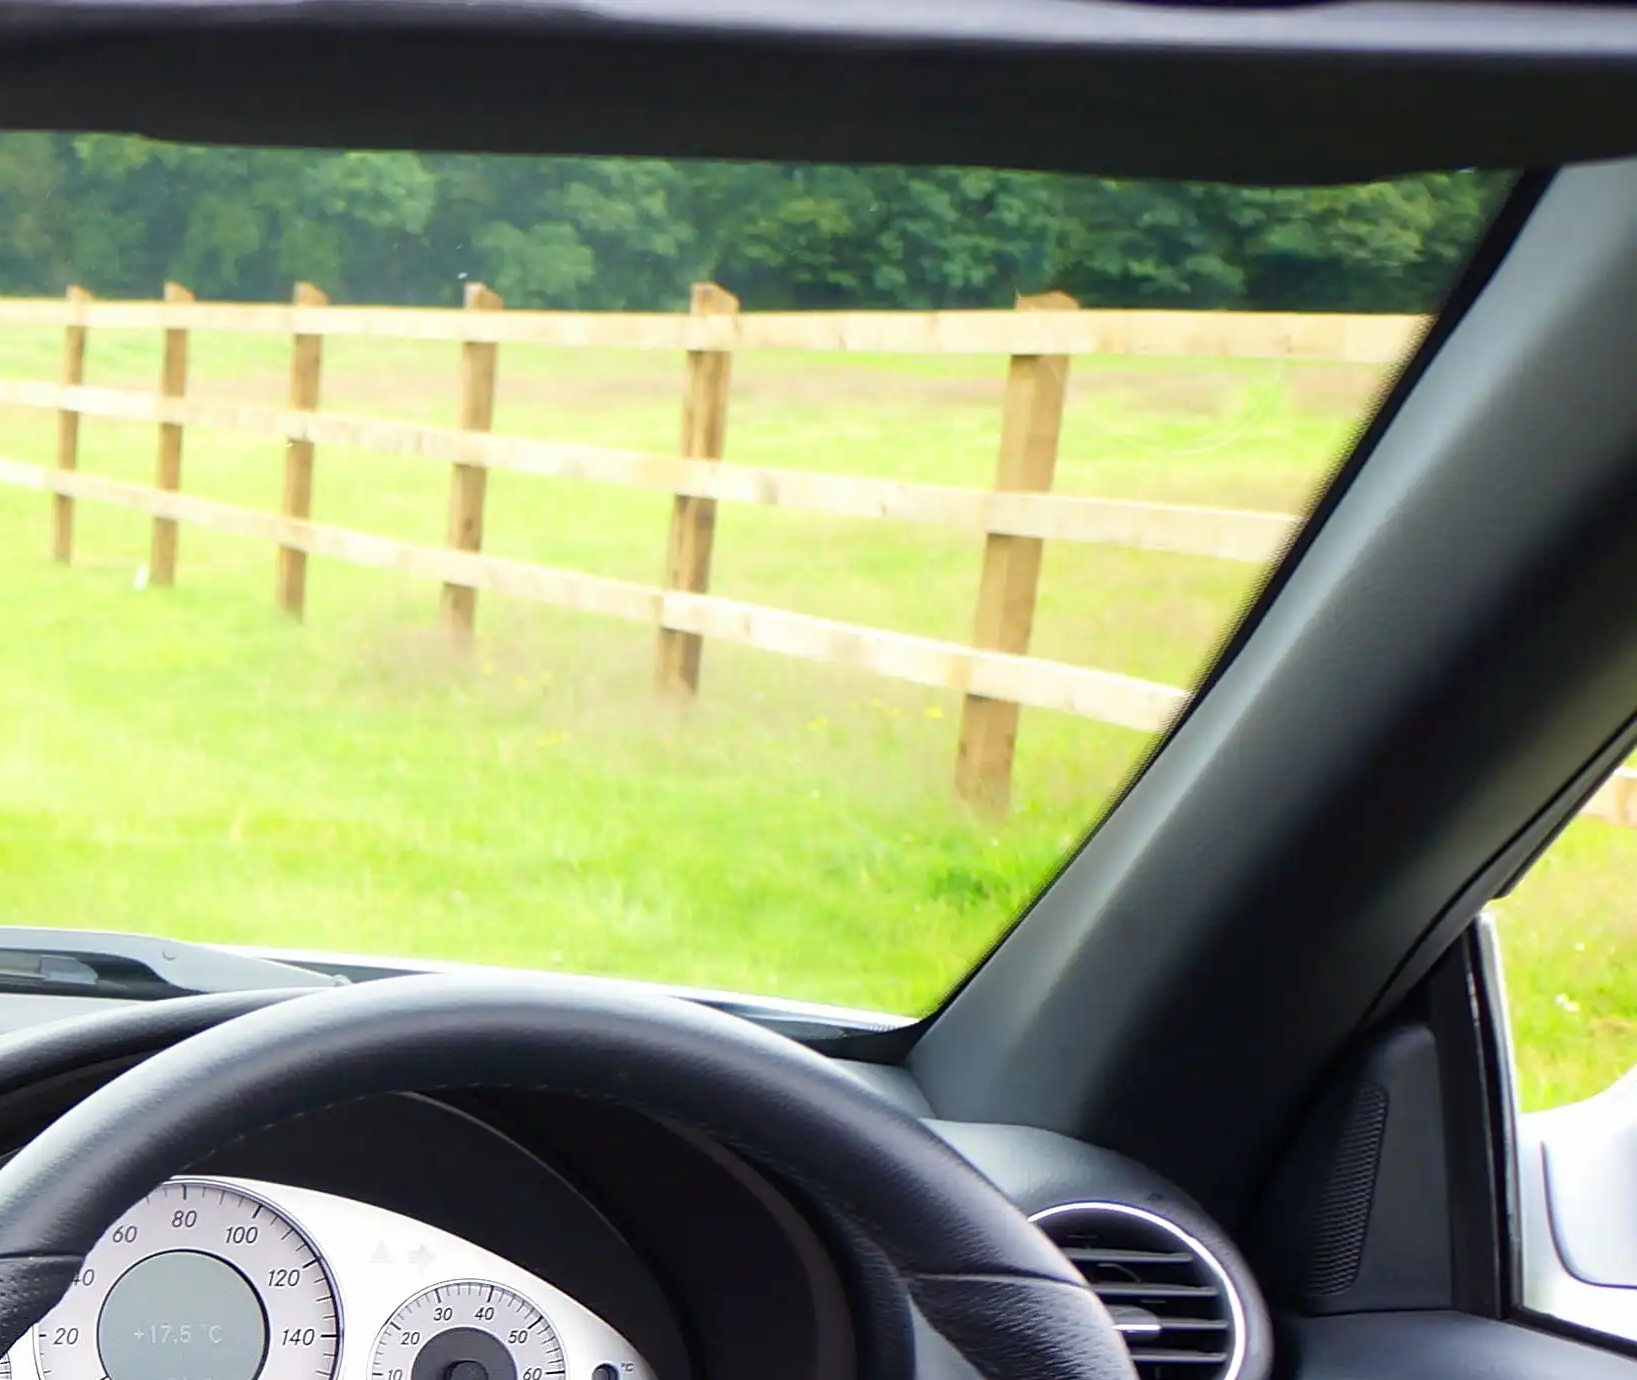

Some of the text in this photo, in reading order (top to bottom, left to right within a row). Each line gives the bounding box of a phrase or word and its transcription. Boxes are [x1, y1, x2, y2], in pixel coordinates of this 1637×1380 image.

[171, 1210, 197, 1228] 80
[112, 1226, 138, 1243] 60
[225, 1226, 259, 1244] 100
[267, 1269, 300, 1287] 120
[433, 1307, 453, 1321] 30
[474, 1306, 495, 1321] 40
[52, 1328, 79, 1345] 20
[281, 1328, 316, 1346] 140
[400, 1332, 421, 1345] 20
[508, 1330, 528, 1344] 50
